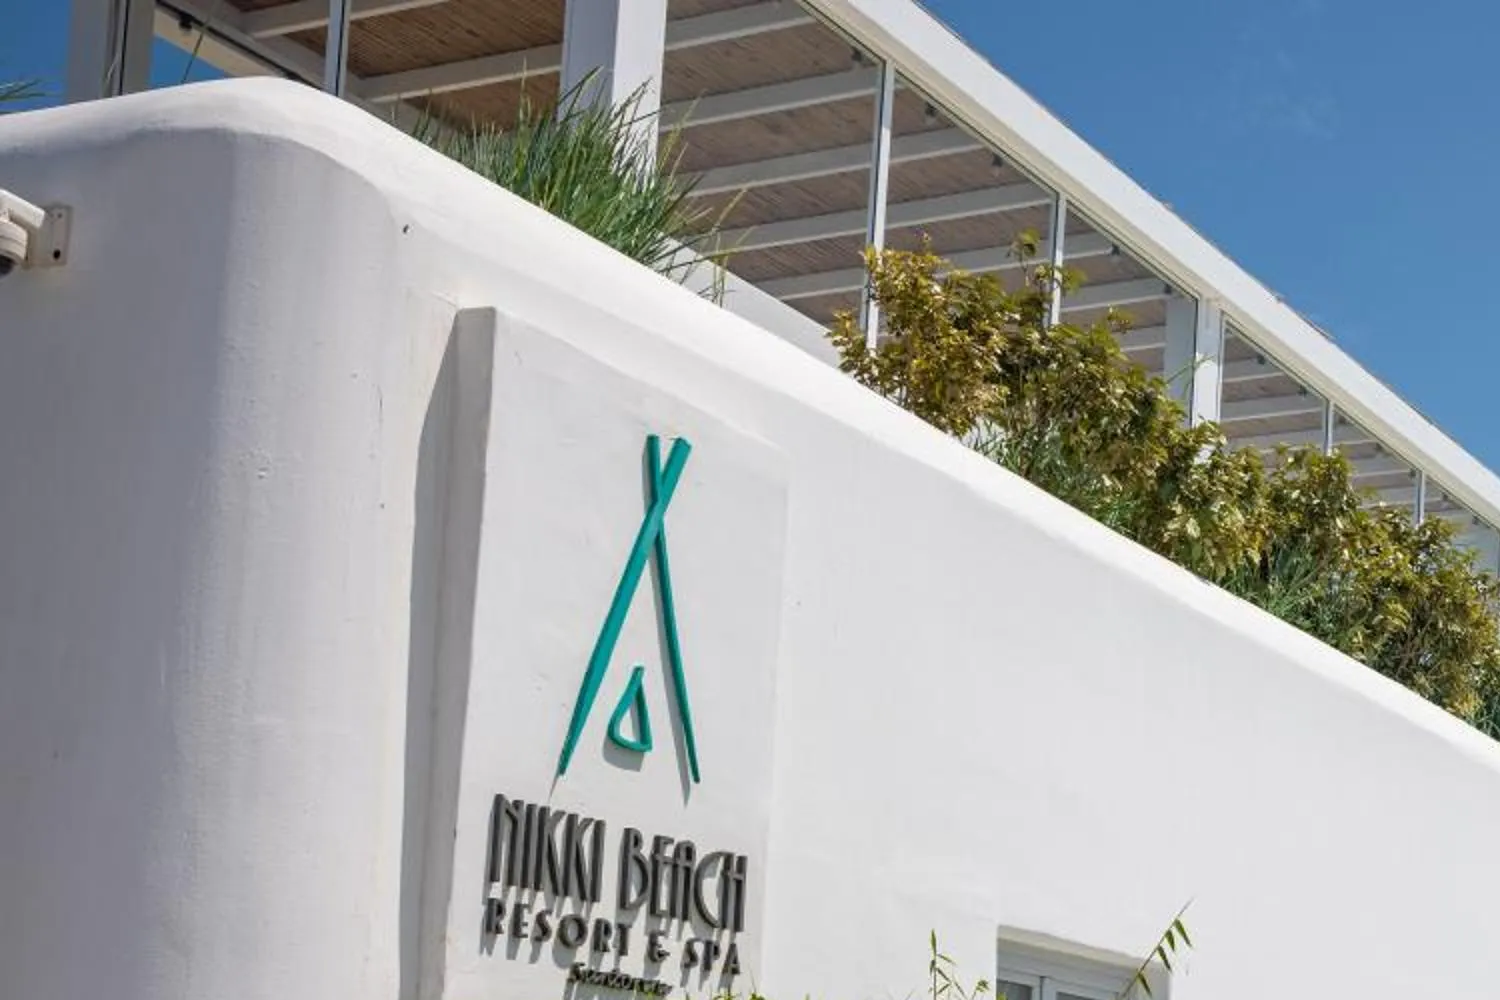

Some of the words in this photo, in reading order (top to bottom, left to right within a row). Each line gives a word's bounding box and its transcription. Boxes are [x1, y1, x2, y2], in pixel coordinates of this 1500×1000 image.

[488, 793, 606, 903] NIKKI
[616, 827, 748, 933] BEACH
[483, 897, 633, 957] RESORT
[647, 931, 671, 963] &
[681, 938, 741, 975] SPA
